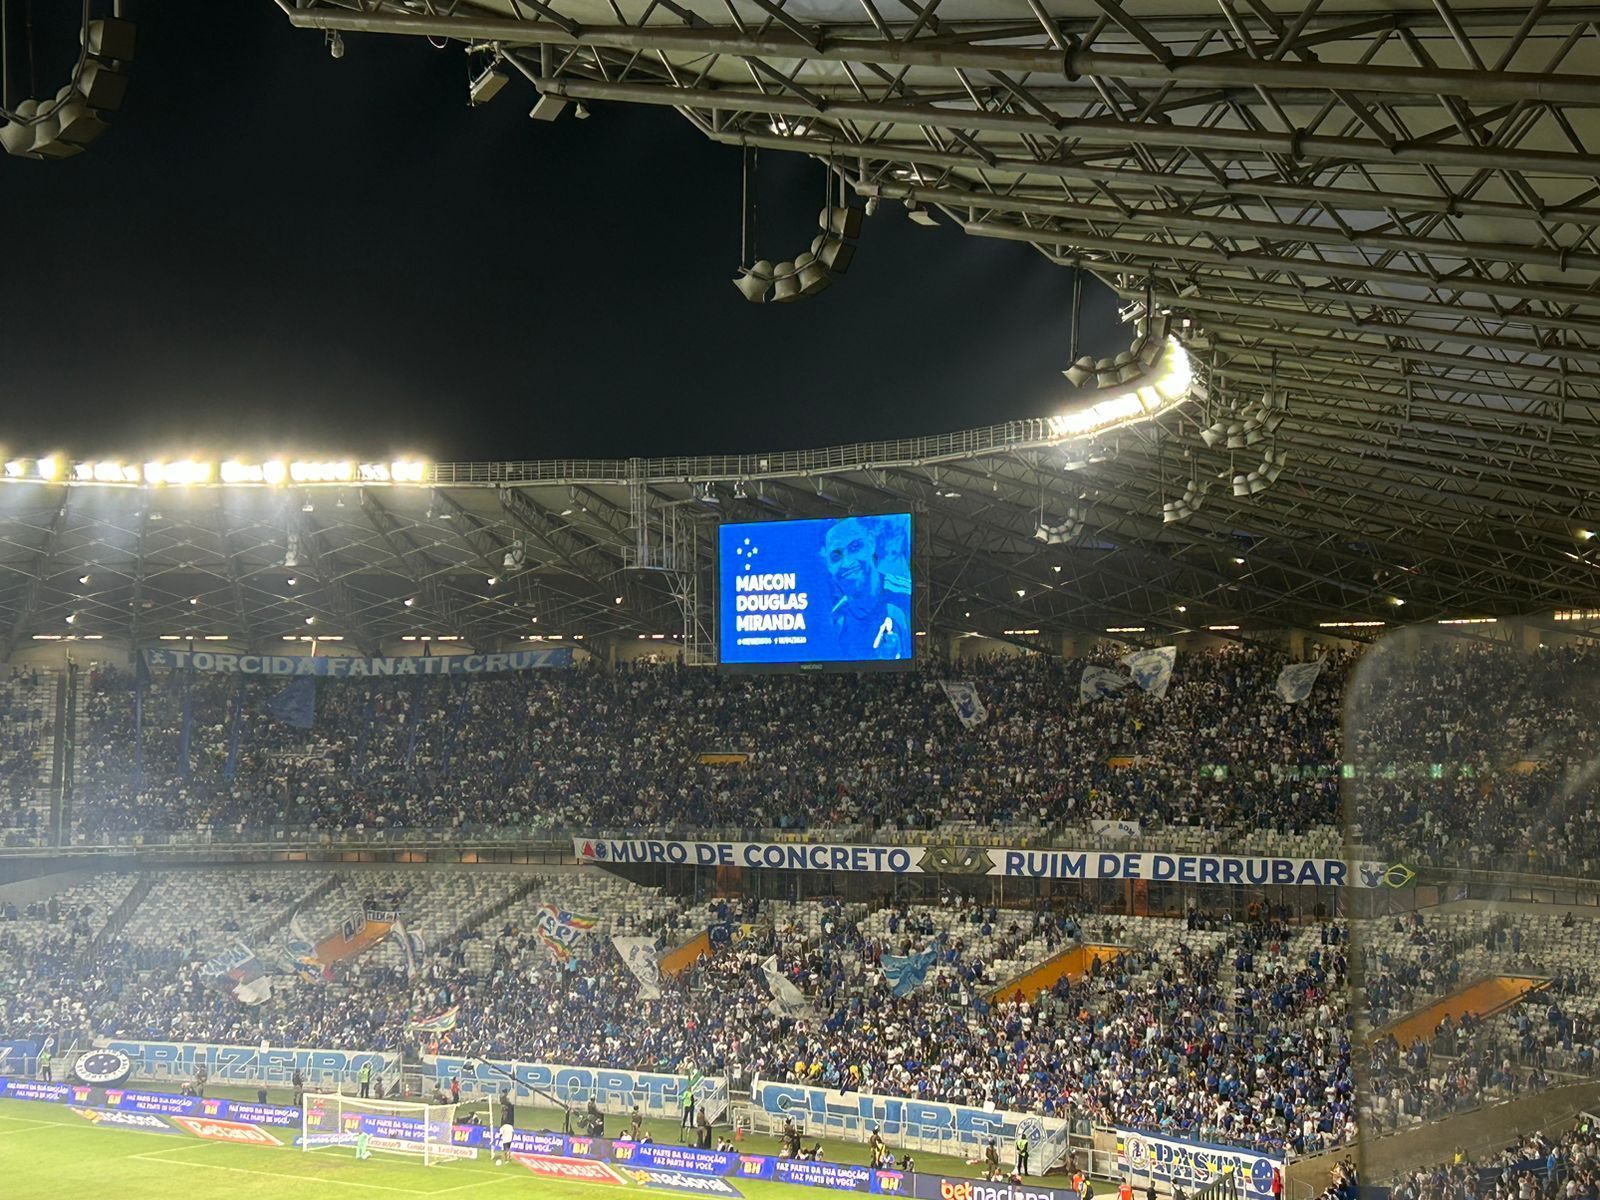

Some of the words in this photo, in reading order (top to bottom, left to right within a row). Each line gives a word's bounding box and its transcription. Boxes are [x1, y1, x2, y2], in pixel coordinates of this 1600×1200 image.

[736, 573, 796, 592] MAICON
[736, 593, 808, 612] DOUGLAS
[736, 613, 806, 632] MIRANDA
[169, 650, 316, 675] TORCIDA
[327, 650, 553, 676] FANATI-CRUZ
[611, 840, 688, 864] MURO
[695, 843, 735, 866] DE
[743, 844, 911, 873] CONCRETO
[1005, 851, 1087, 878] RUIM
[1098, 854, 1142, 878] DE
[1152, 855, 1347, 886] DERRUBAR
[762, 1084, 1003, 1146] CLUBE
[573, 1142, 588, 1154] BH
[616, 1148, 632, 1160] BH
[743, 1162, 760, 1174] BH
[776, 1162, 788, 1171] FAZ
[790, 1164, 810, 1172] PARTE
[811, 1166, 820, 1174] DA
[822, 1166, 836, 1176] SUA
[791, 1172, 804, 1180] FAZ
[805, 1174, 824, 1184] PARTE
[826, 1176, 834, 1186] DE
[881, 1177, 898, 1190] BH
